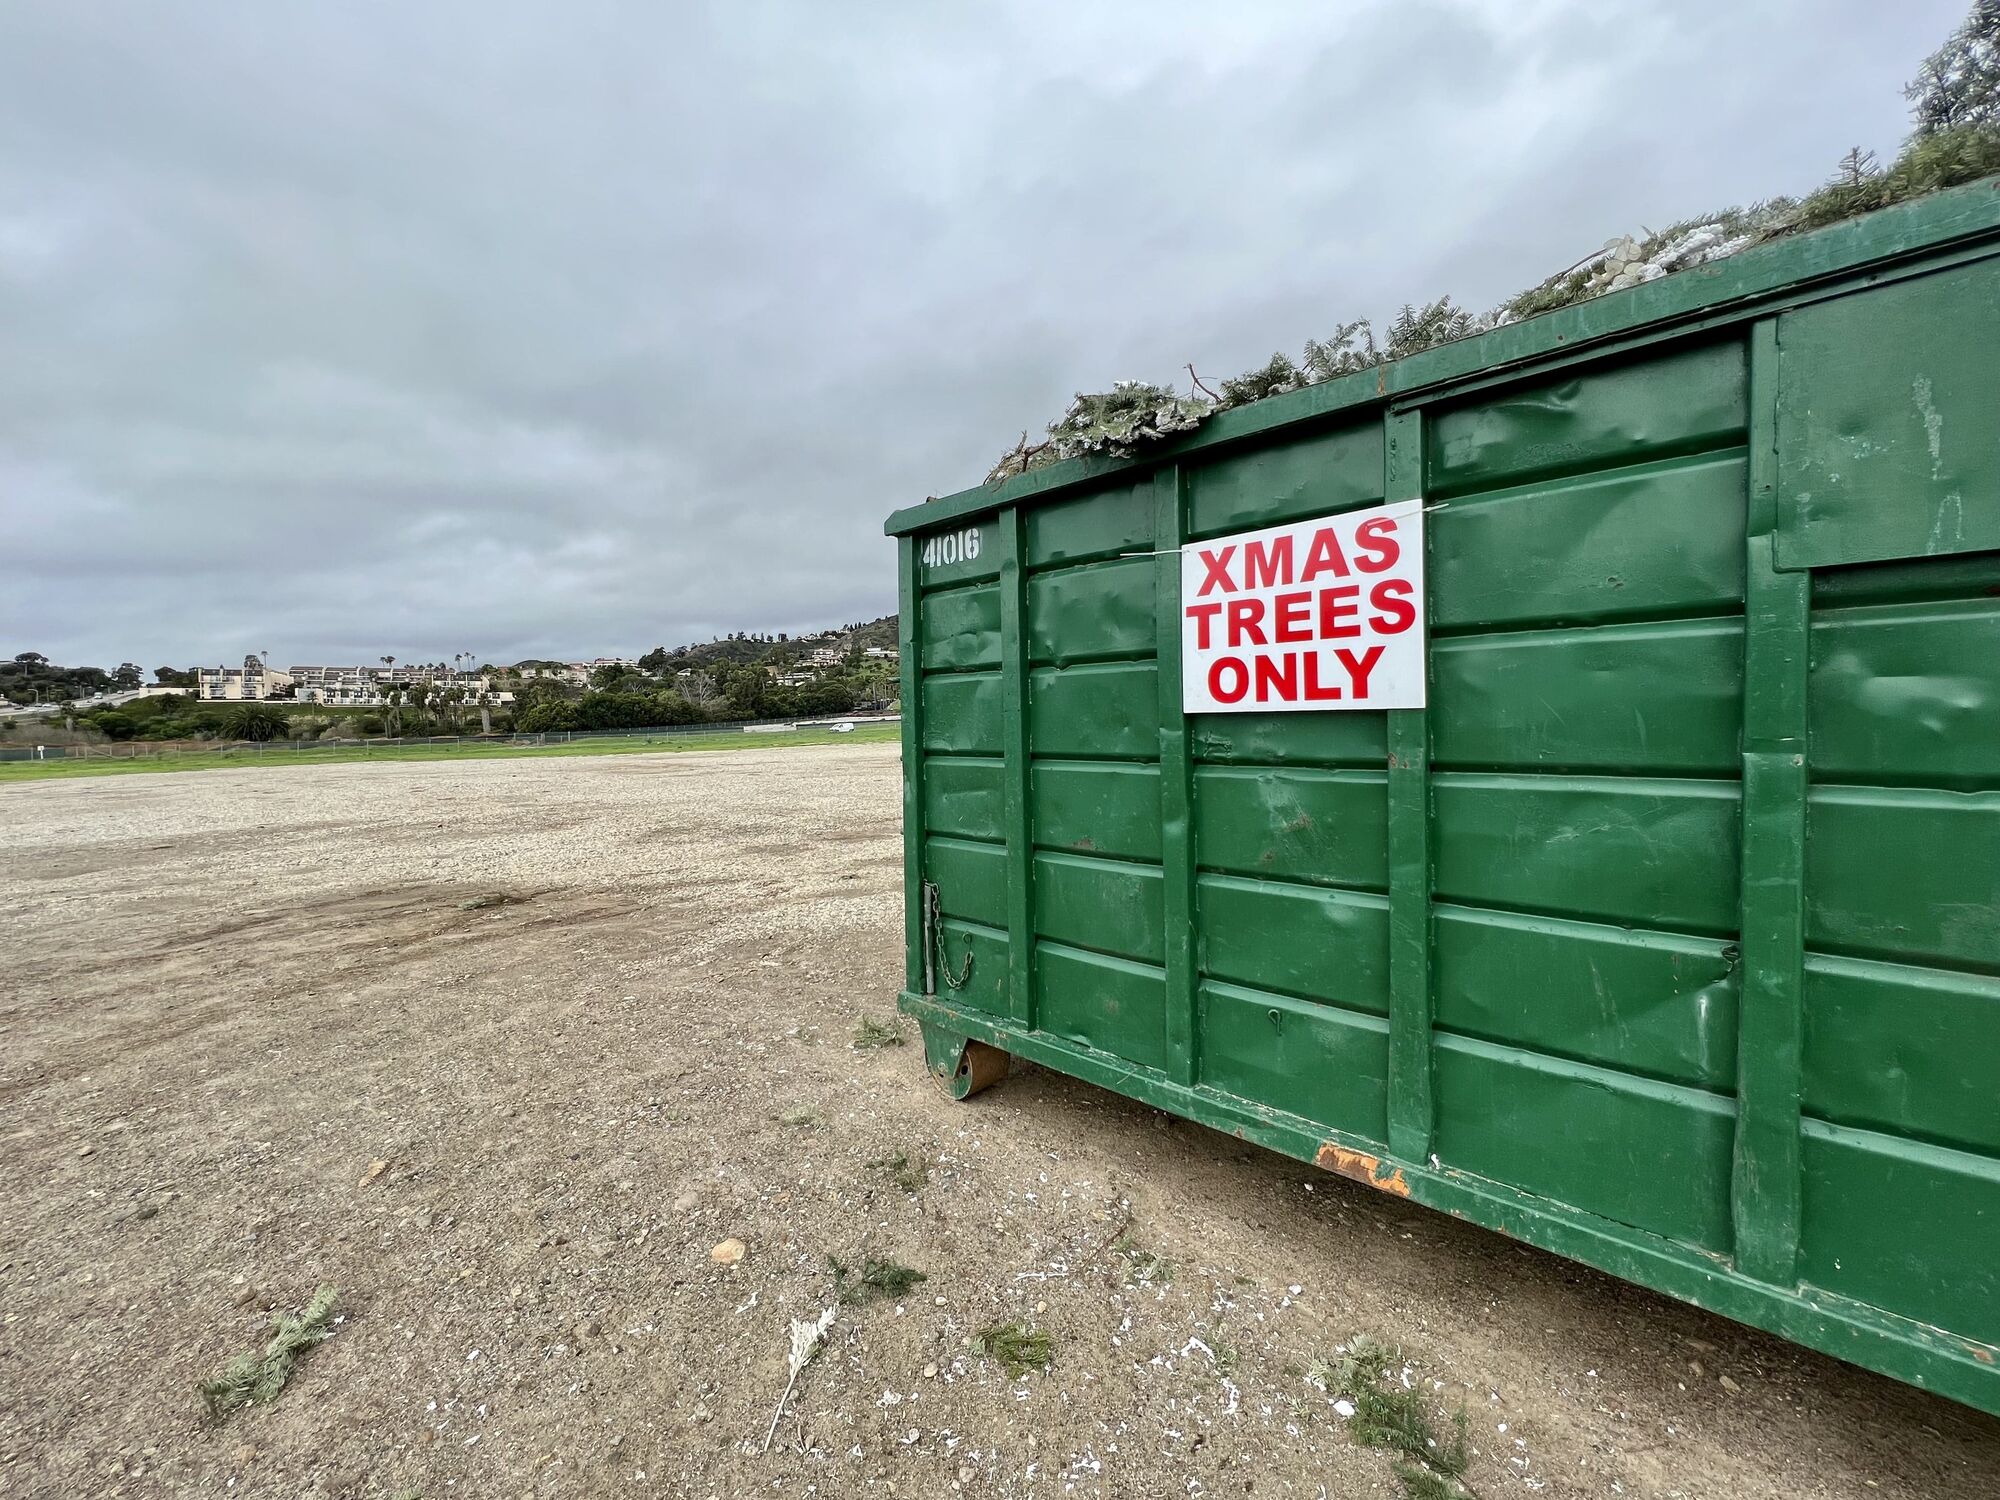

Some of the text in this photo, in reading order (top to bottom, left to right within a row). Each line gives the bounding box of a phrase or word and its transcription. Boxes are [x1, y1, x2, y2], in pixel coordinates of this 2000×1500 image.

[922, 527, 980, 568] 41016
[1197, 517, 1401, 597] XMAS
[1185, 578, 1417, 651] TREES
[1207, 645, 1386, 705] ONLY
